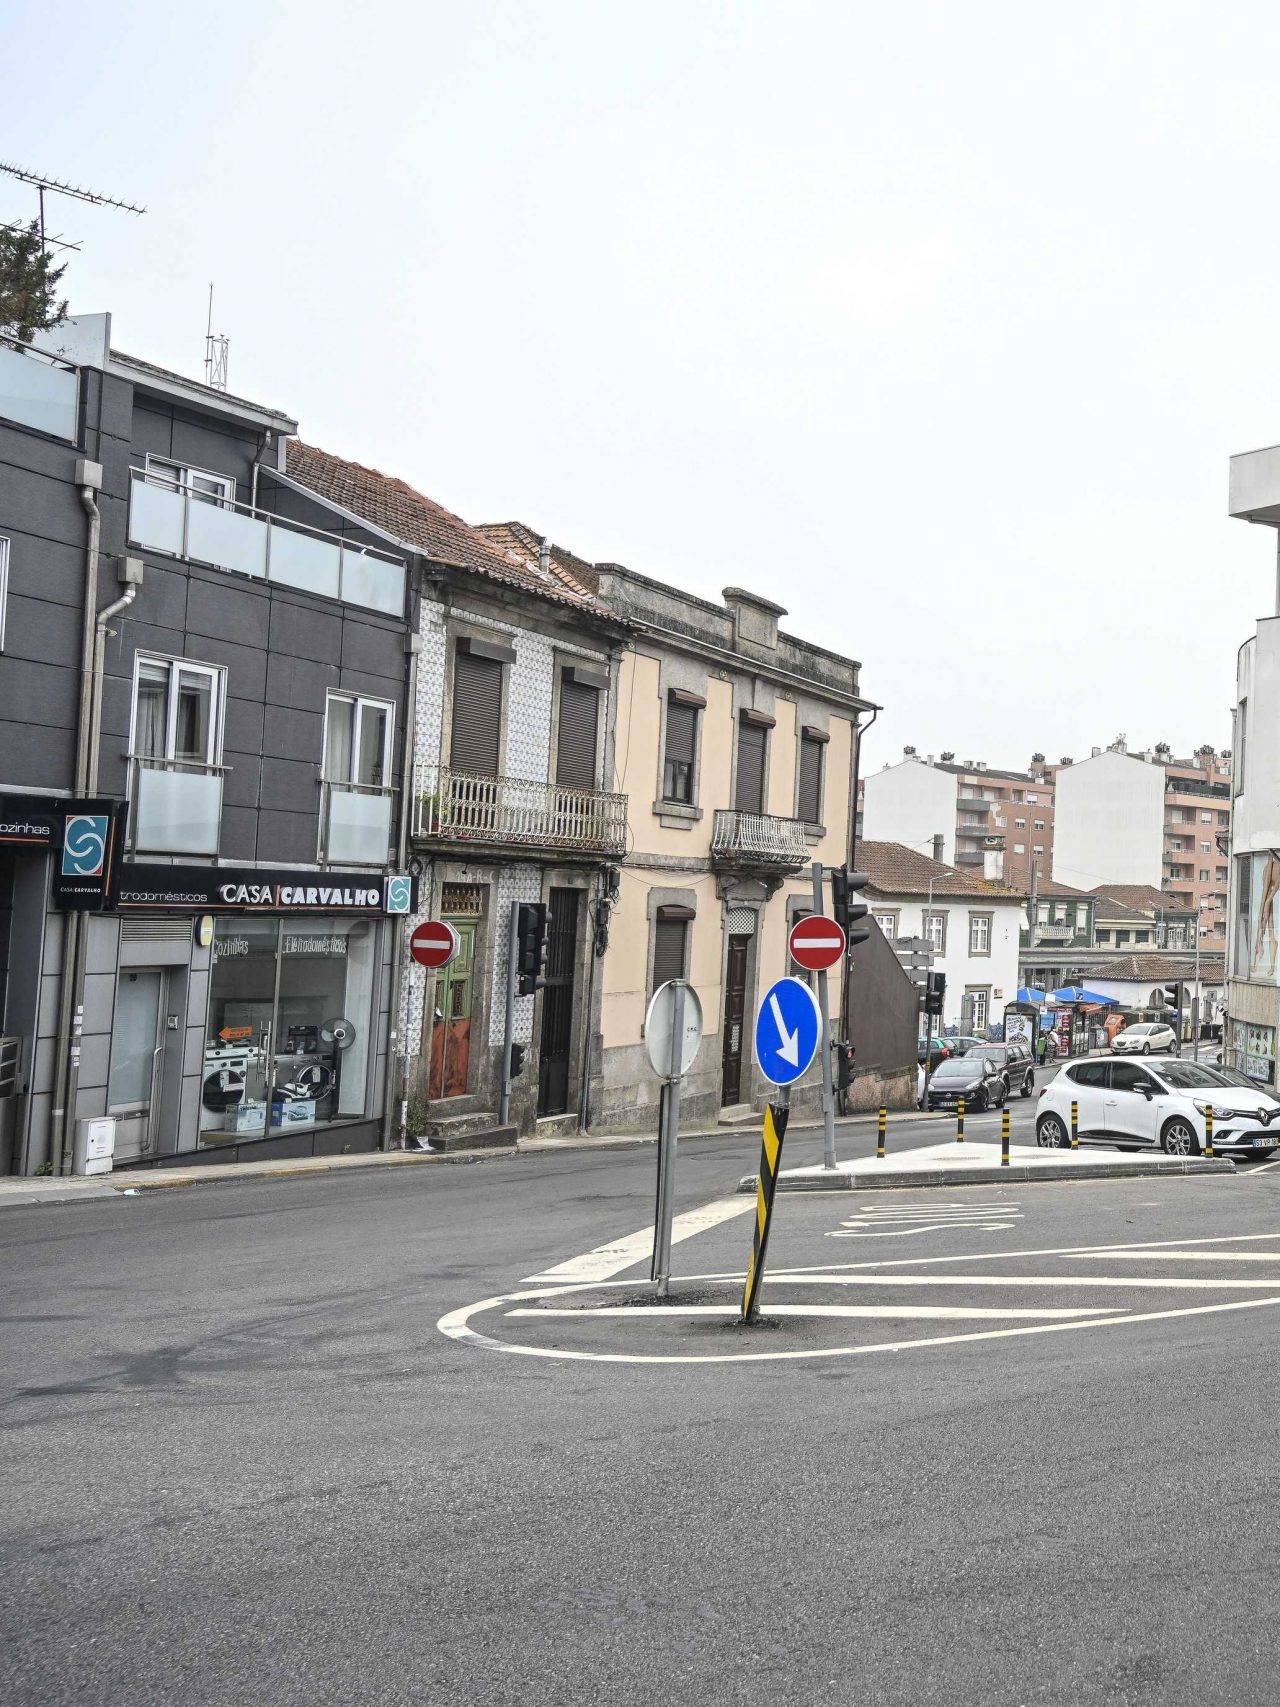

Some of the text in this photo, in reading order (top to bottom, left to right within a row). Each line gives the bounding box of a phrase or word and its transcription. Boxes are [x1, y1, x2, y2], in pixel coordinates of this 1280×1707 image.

[119, 891, 207, 902] trodomésticos
[220, 884, 379, 905] CASA CARVALHO
